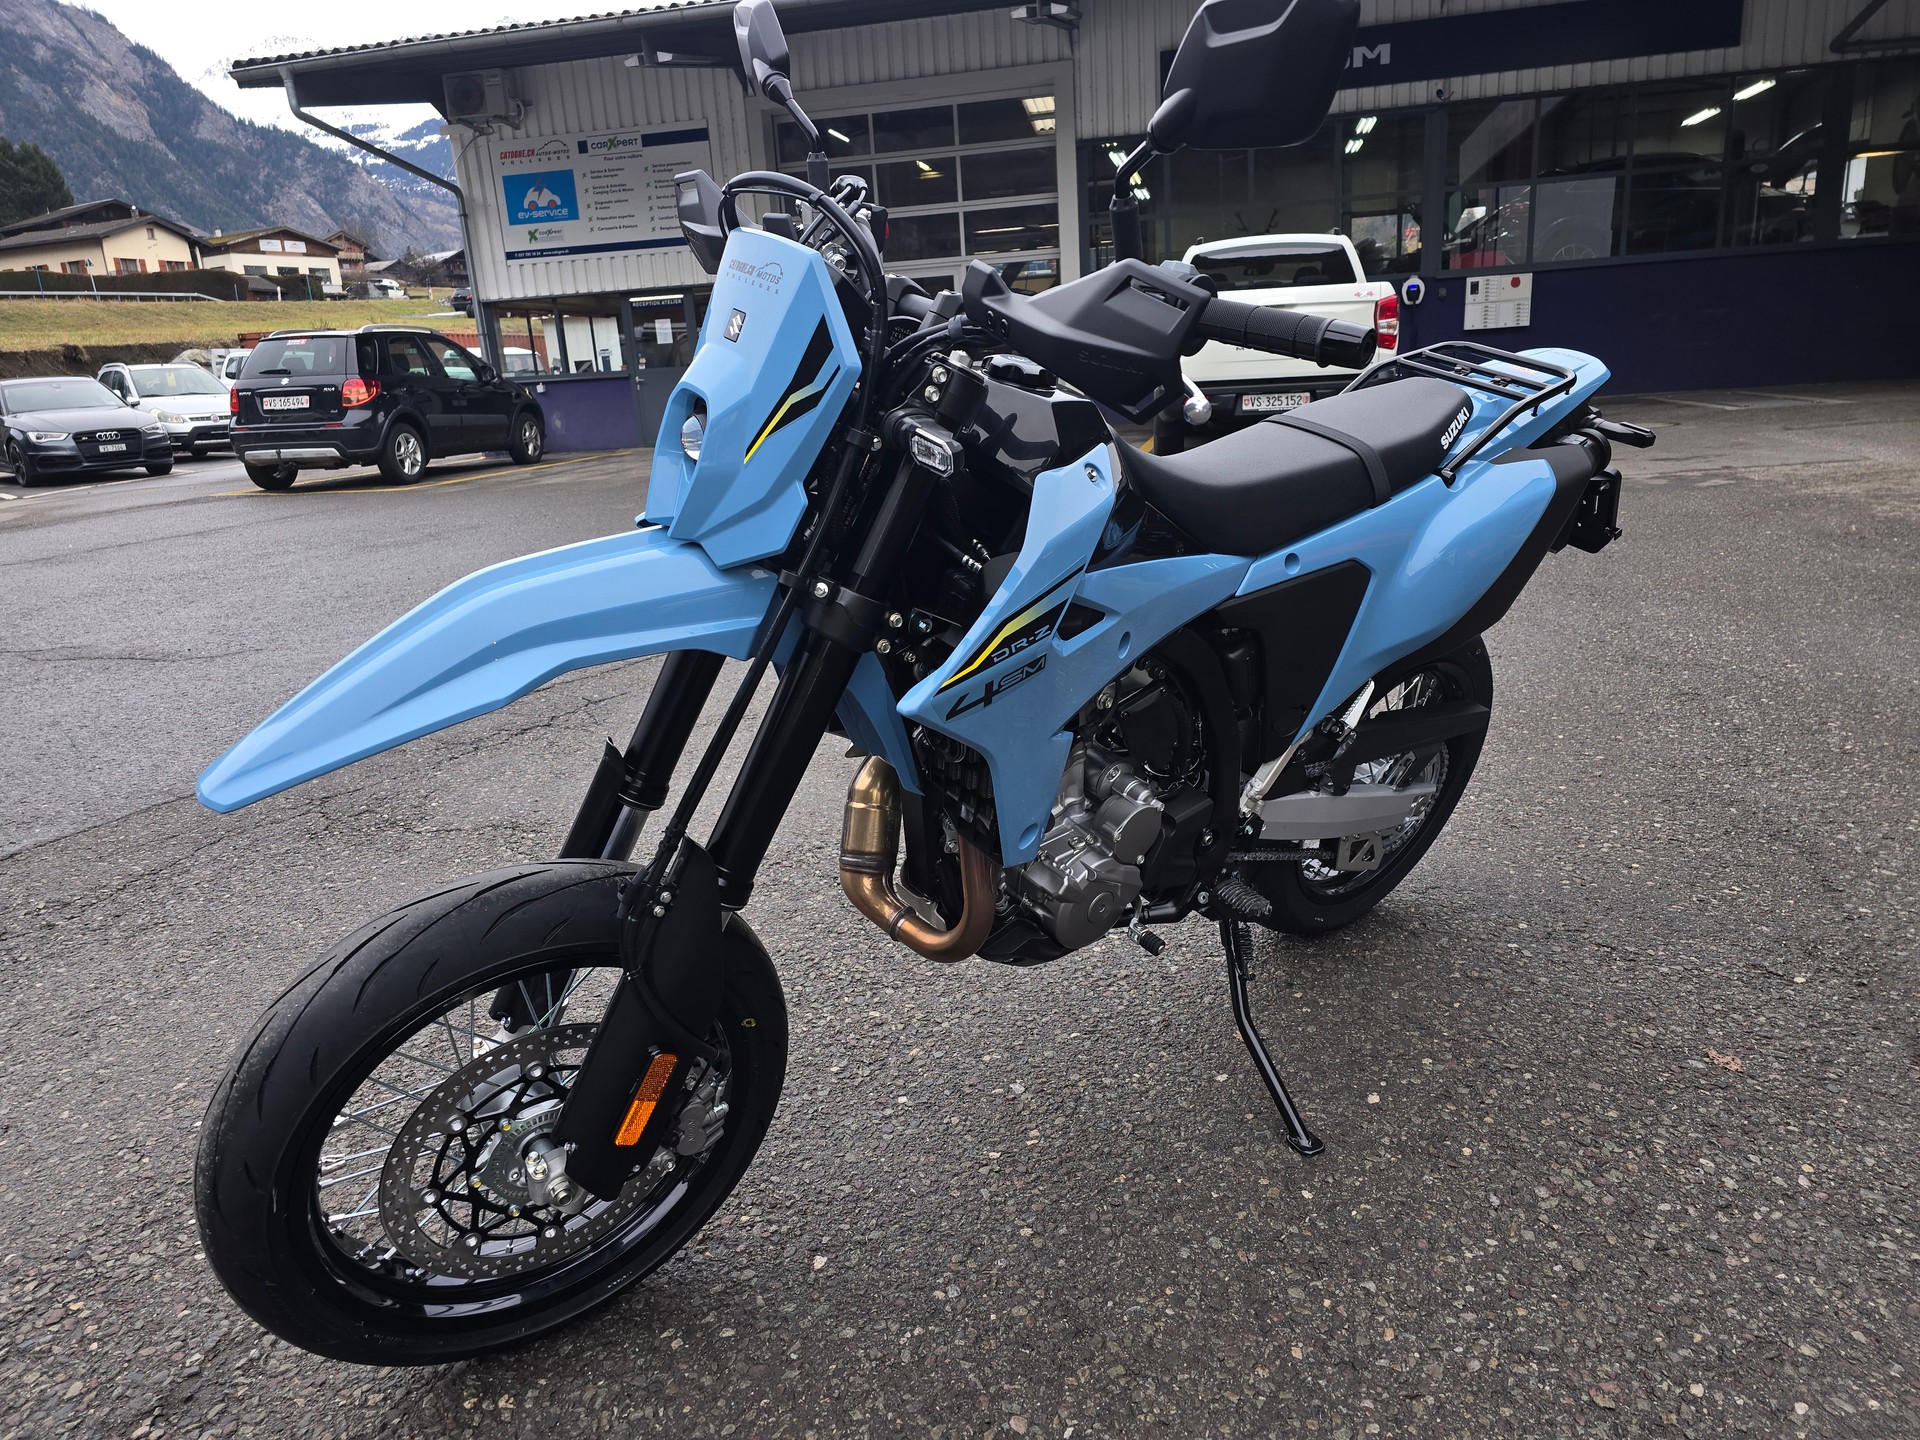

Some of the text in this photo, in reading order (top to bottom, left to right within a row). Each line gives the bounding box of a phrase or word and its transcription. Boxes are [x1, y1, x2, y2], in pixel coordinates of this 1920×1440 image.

[518, 208, 568, 219] ev-service
[756, 270, 782, 285] MOTOS
[1440, 406, 1470, 450] SUZUKI
[991, 624, 1051, 663] DR-Z
